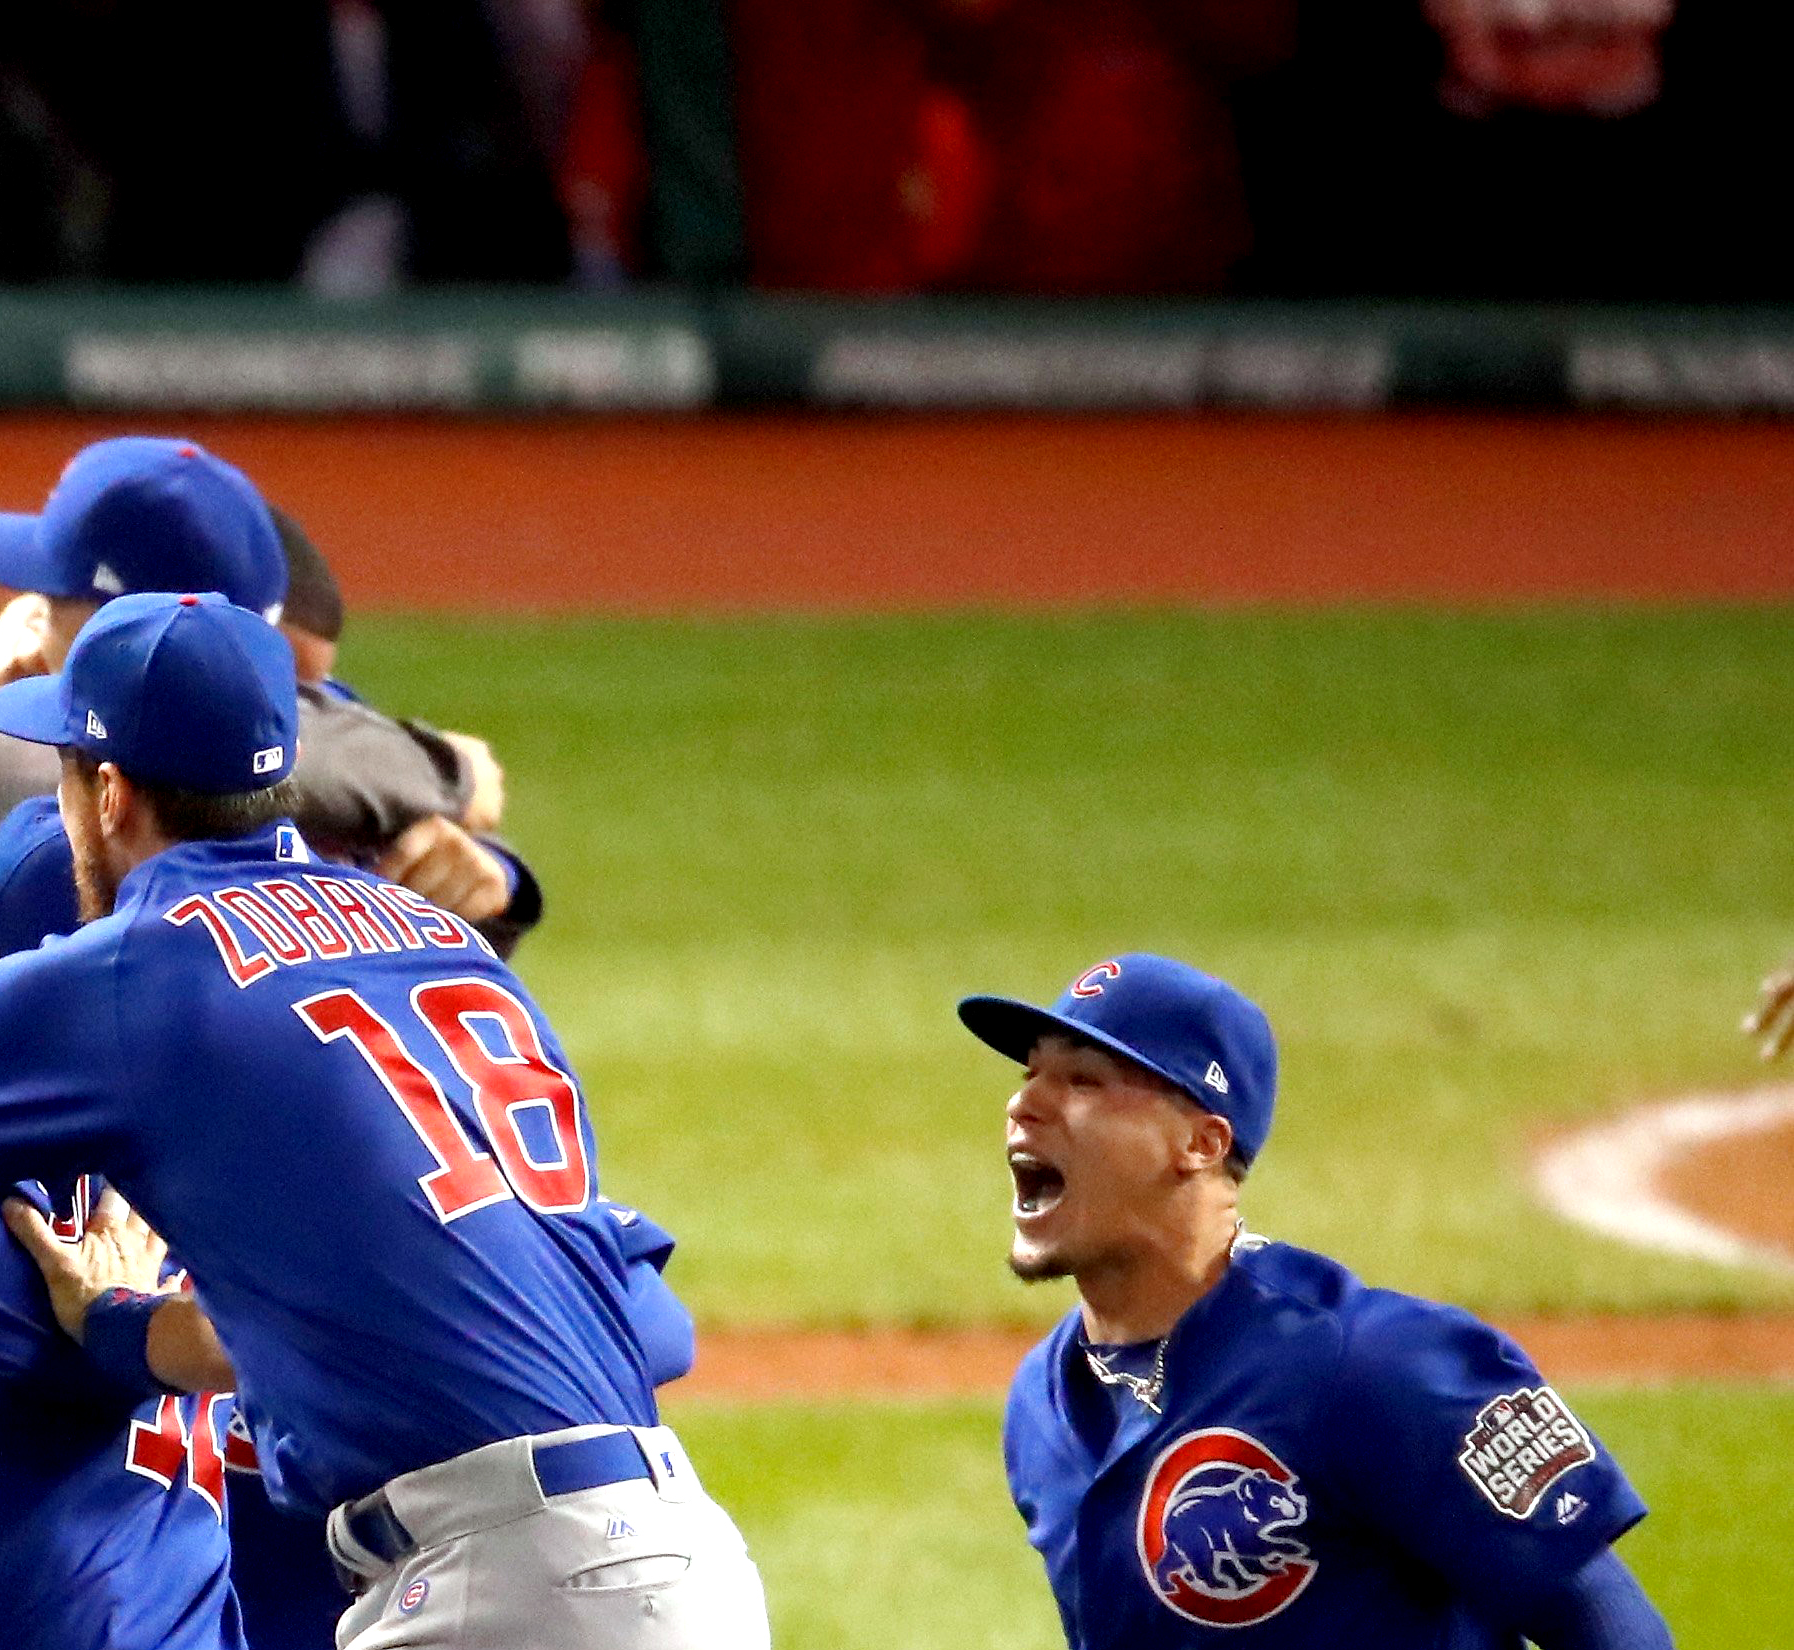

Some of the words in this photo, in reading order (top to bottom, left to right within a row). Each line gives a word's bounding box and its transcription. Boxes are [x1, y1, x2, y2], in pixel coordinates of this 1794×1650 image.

[1070, 960, 1122, 1000] C
[291, 977, 591, 1223] 18
[1467, 1395, 1557, 1478] WORLD
[1488, 1418, 1581, 1504] SERIES
